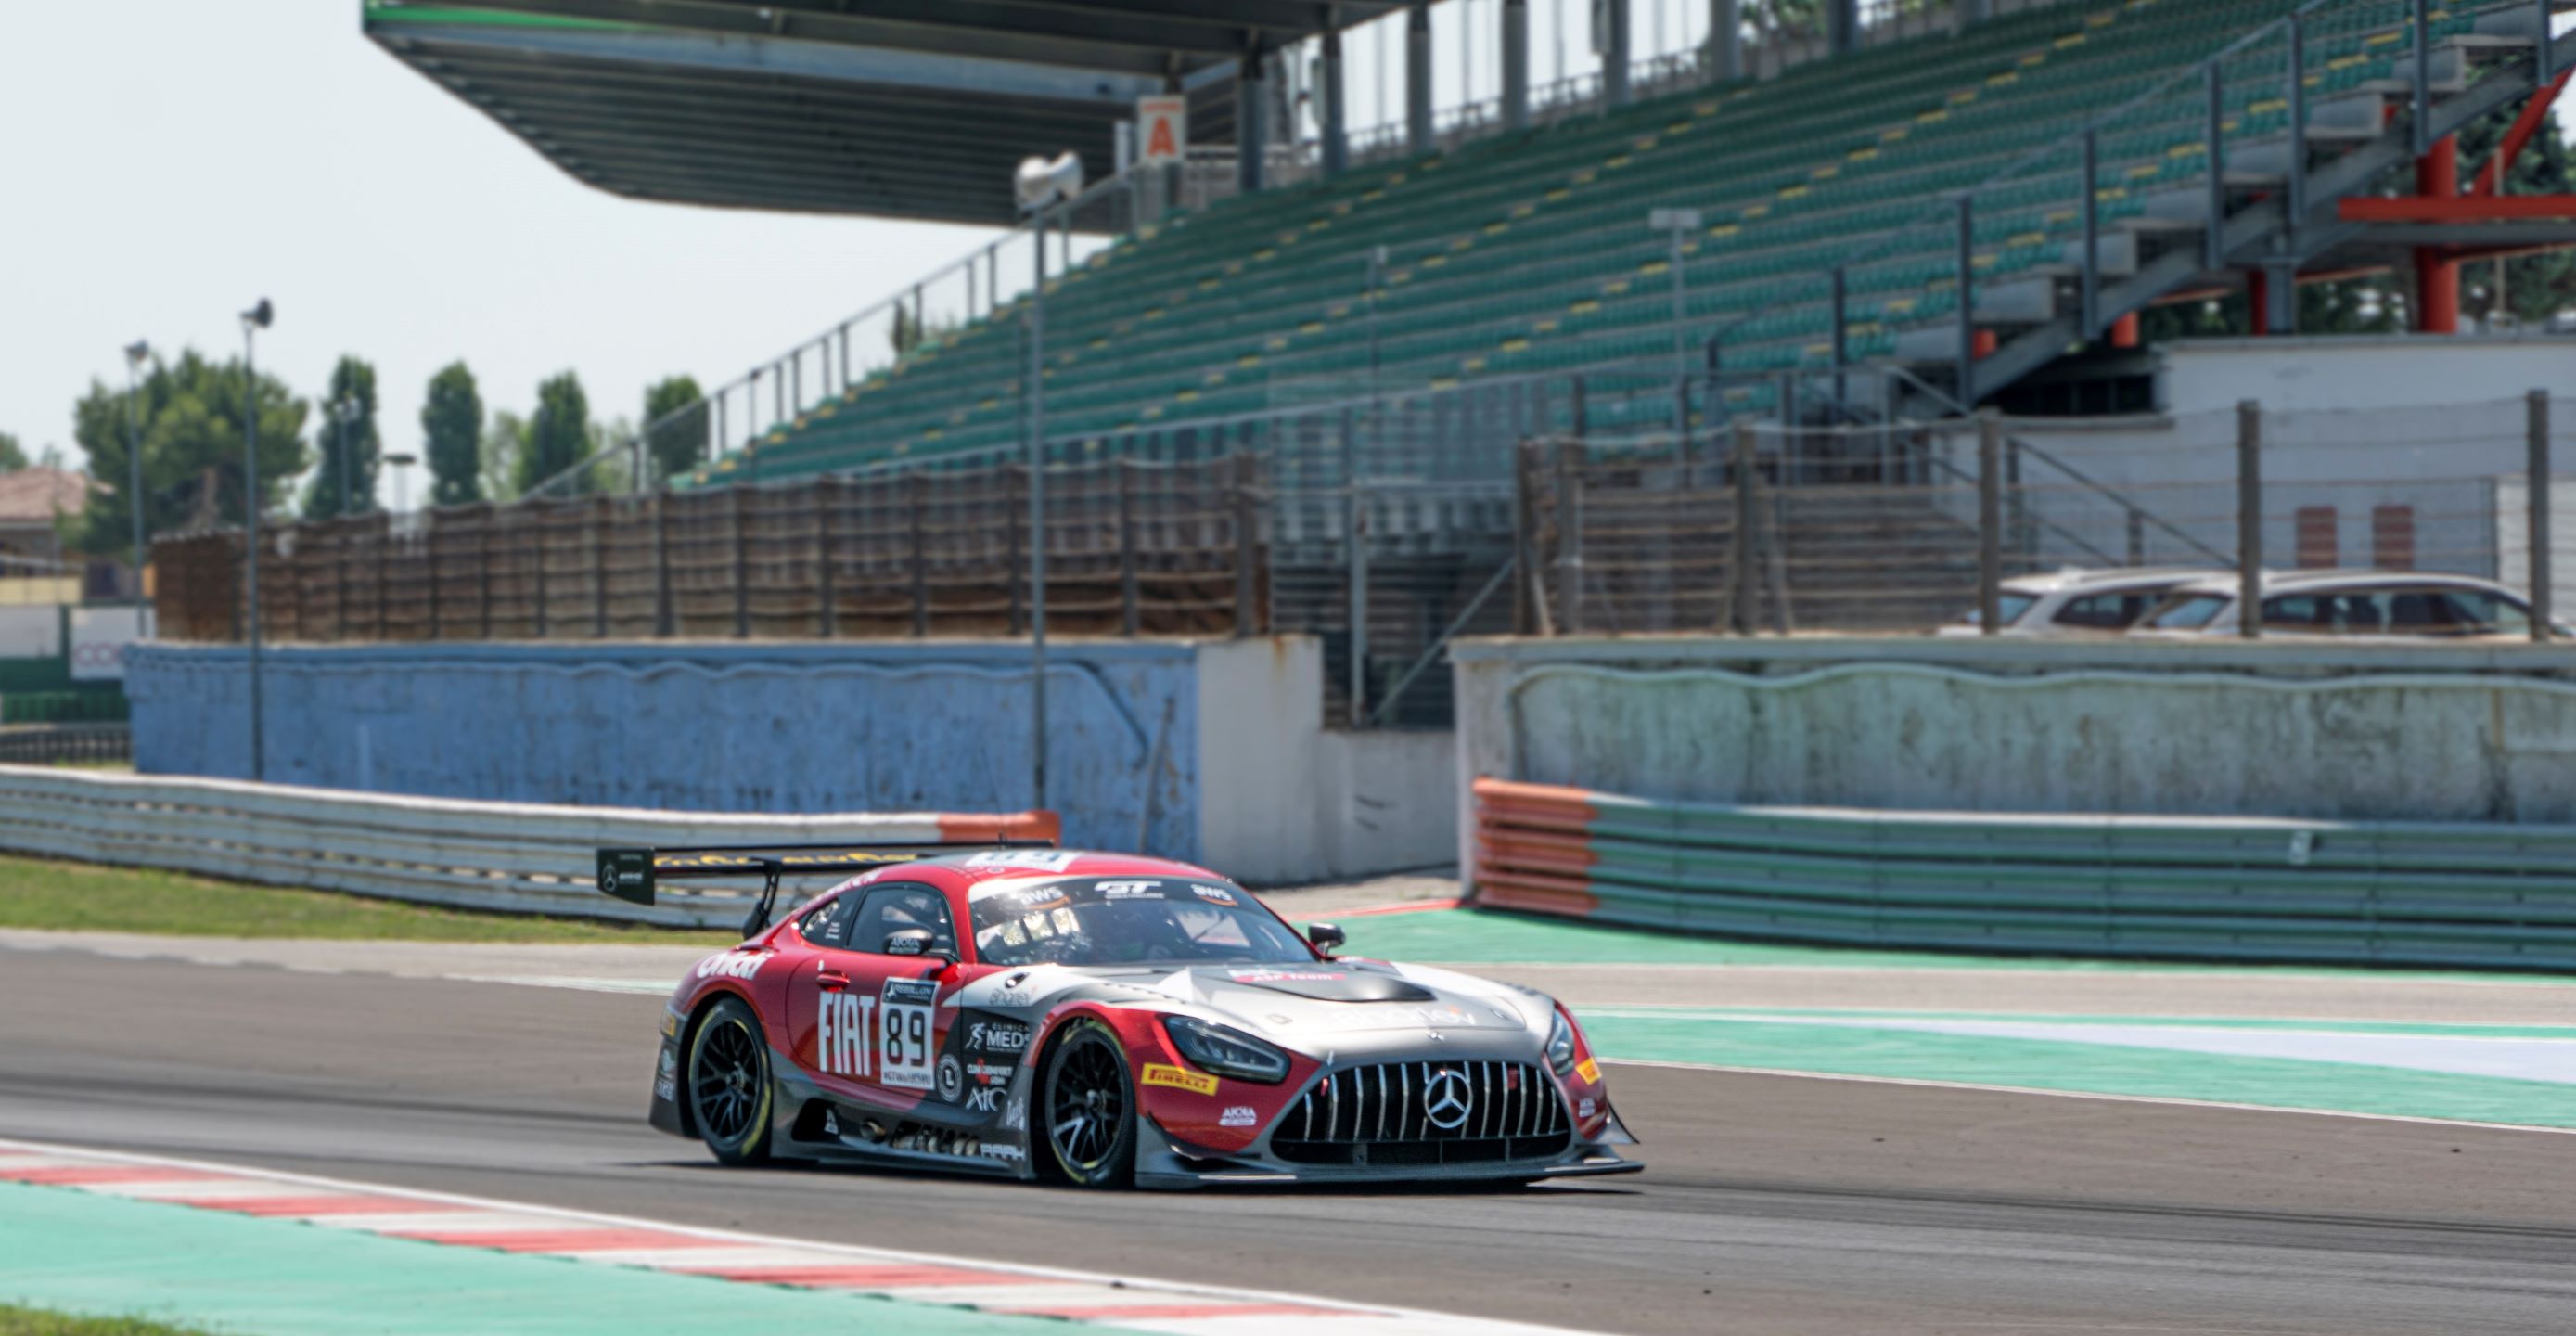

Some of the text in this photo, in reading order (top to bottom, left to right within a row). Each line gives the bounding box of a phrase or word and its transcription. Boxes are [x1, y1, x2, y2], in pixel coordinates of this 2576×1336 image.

[1147, 116, 1177, 157] A
[818, 991, 876, 1076] FIAT
[885, 1008, 926, 1068] 89
[1148, 1069, 1210, 1090] PIRELLI
